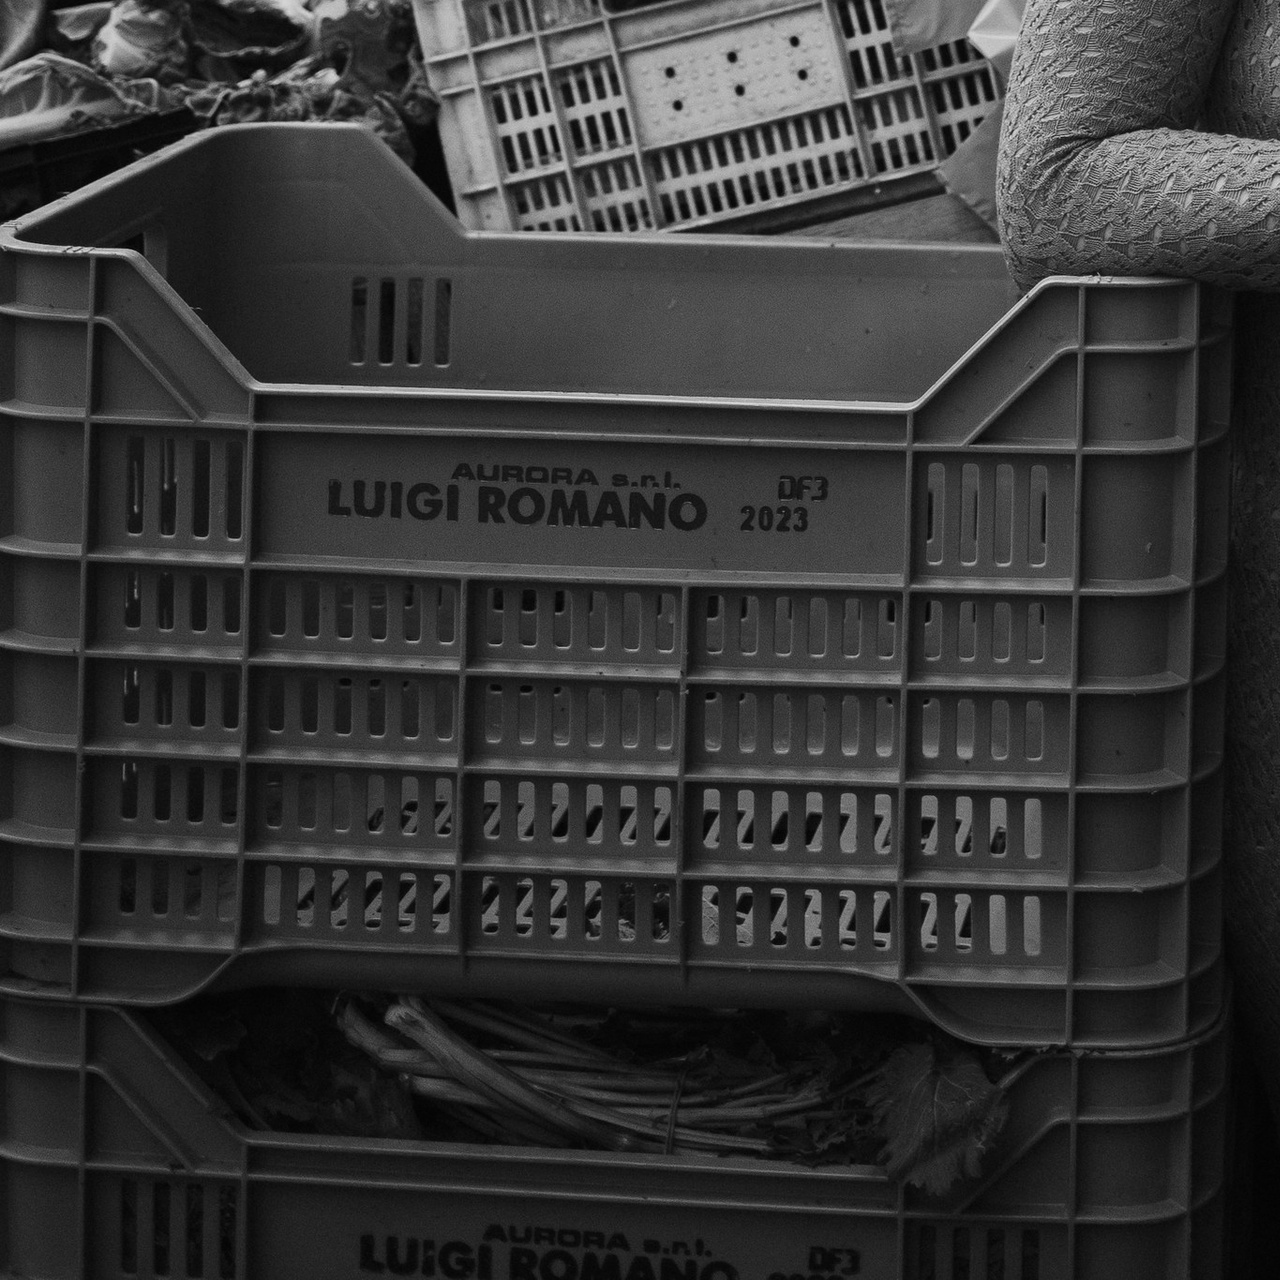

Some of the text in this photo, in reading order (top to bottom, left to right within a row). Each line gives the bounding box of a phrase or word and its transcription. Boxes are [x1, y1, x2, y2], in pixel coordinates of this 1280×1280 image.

[451, 463, 681, 489] AURORA s.r.l.
[778, 475, 829, 502] DF3
[328, 479, 708, 531] LUIGI ROMANO
[740, 505, 809, 532] 2023
[482, 1224, 630, 1251] AURORA
[360, 1234, 492, 1280] LUIGI
